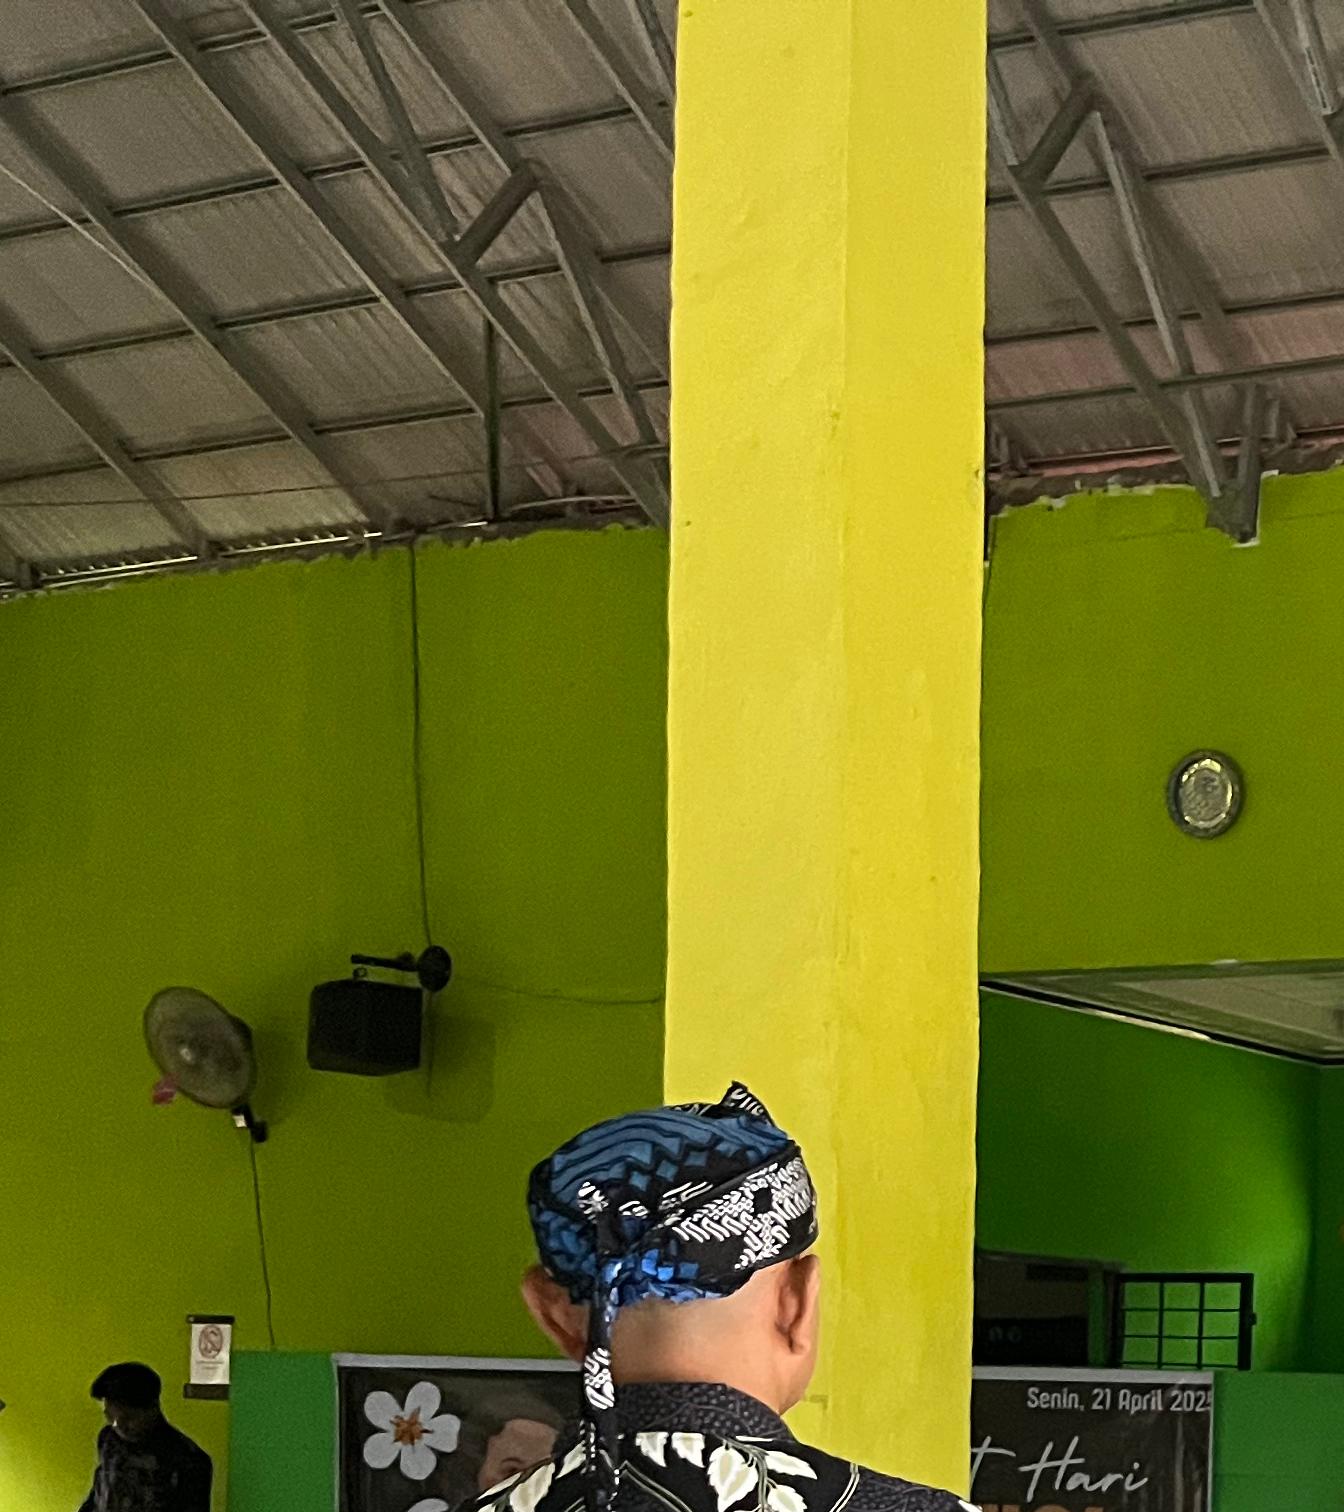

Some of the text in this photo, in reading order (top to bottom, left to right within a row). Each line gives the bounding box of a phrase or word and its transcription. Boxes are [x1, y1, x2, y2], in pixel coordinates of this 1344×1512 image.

[1027, 1386, 1084, 1411] Senin,
[1091, 1388, 1111, 1410] 21
[1118, 1388, 1163, 1416] April
[1018, 1436, 1148, 1503] Hari
